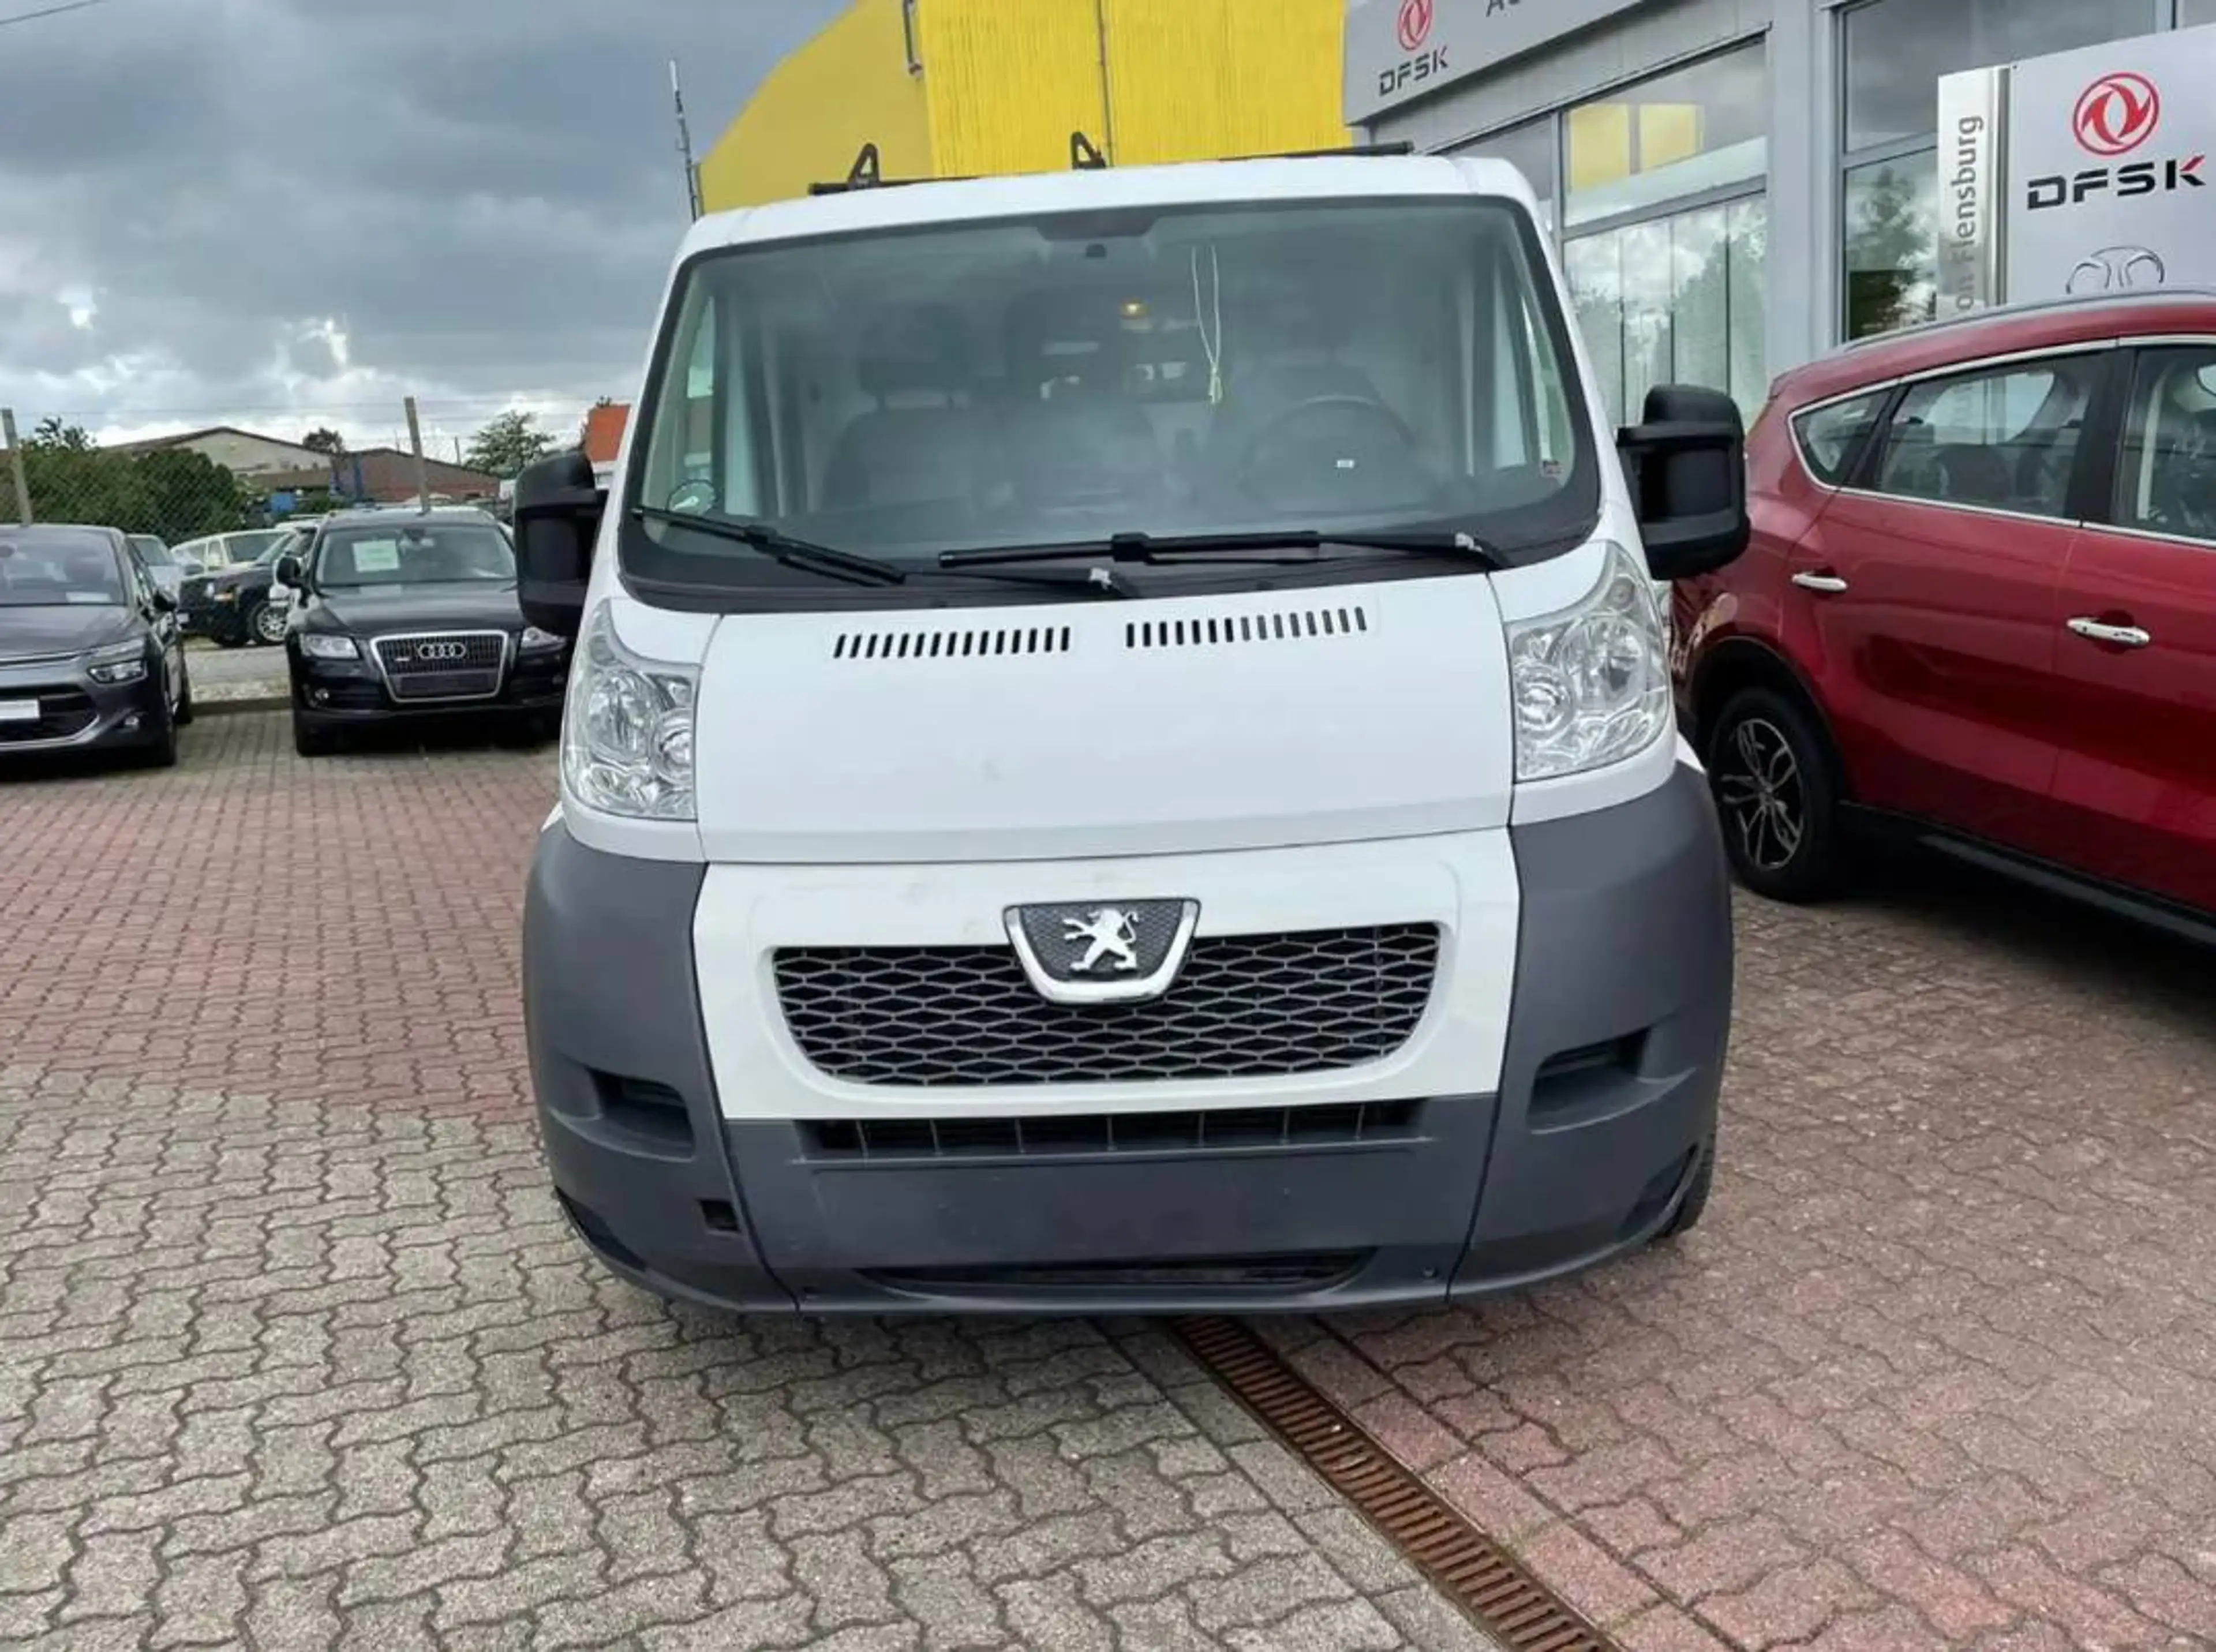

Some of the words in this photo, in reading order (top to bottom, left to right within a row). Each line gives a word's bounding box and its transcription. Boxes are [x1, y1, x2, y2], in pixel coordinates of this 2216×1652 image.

[1379, 46, 1448, 97] DFSK
[1950, 115, 1984, 263] Flensburg
[2027, 155, 2206, 210] DFSK
